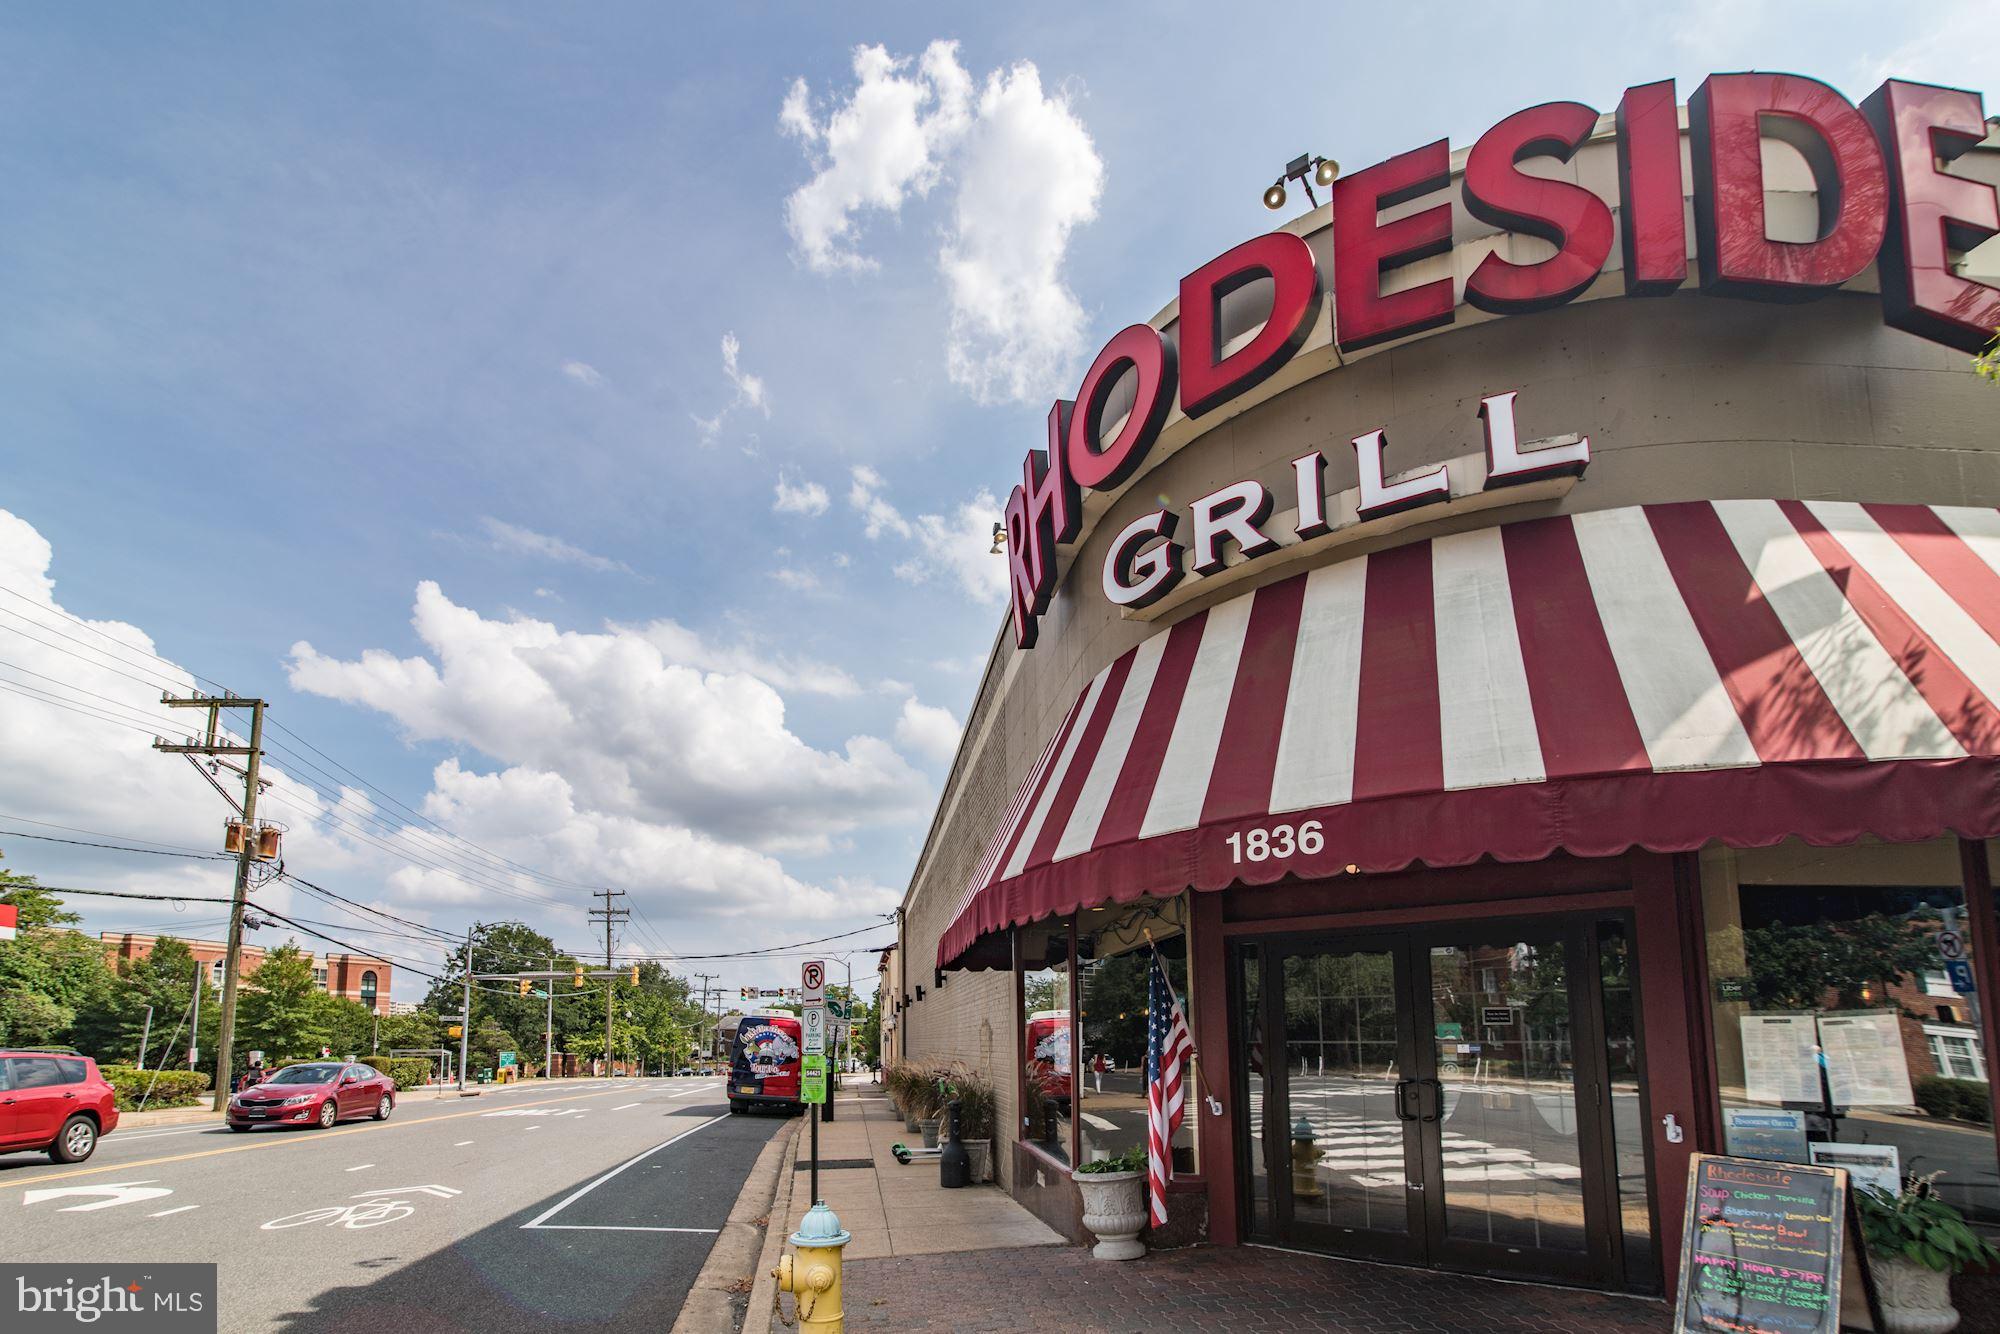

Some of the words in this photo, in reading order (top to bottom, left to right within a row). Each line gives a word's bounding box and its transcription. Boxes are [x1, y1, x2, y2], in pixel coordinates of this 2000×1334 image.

[1005, 71, 2000, 648] RHODESIDE
[1102, 391, 1590, 609] GRILL
[1225, 820, 1325, 864] 1836
[1707, 1164, 1793, 1185] Rhodeside
[1700, 1184, 1730, 1200] Soup
[1733, 1190, 1771, 1201] Chicken
[1700, 1203, 1721, 1215] Pie
[1724, 1206, 1772, 1219] Blueberry
[1777, 1224, 1808, 1239] Bowl
[1695, 1254, 1736, 1271] HAPPY
[1743, 1262, 1777, 1276] HOUR
[1780, 1268, 1826, 1284] 3-7PM
[1736, 1271, 1752, 1281] All
[1755, 1274, 1789, 1286] Draft
[1791, 1279, 1822, 1292] Beers
